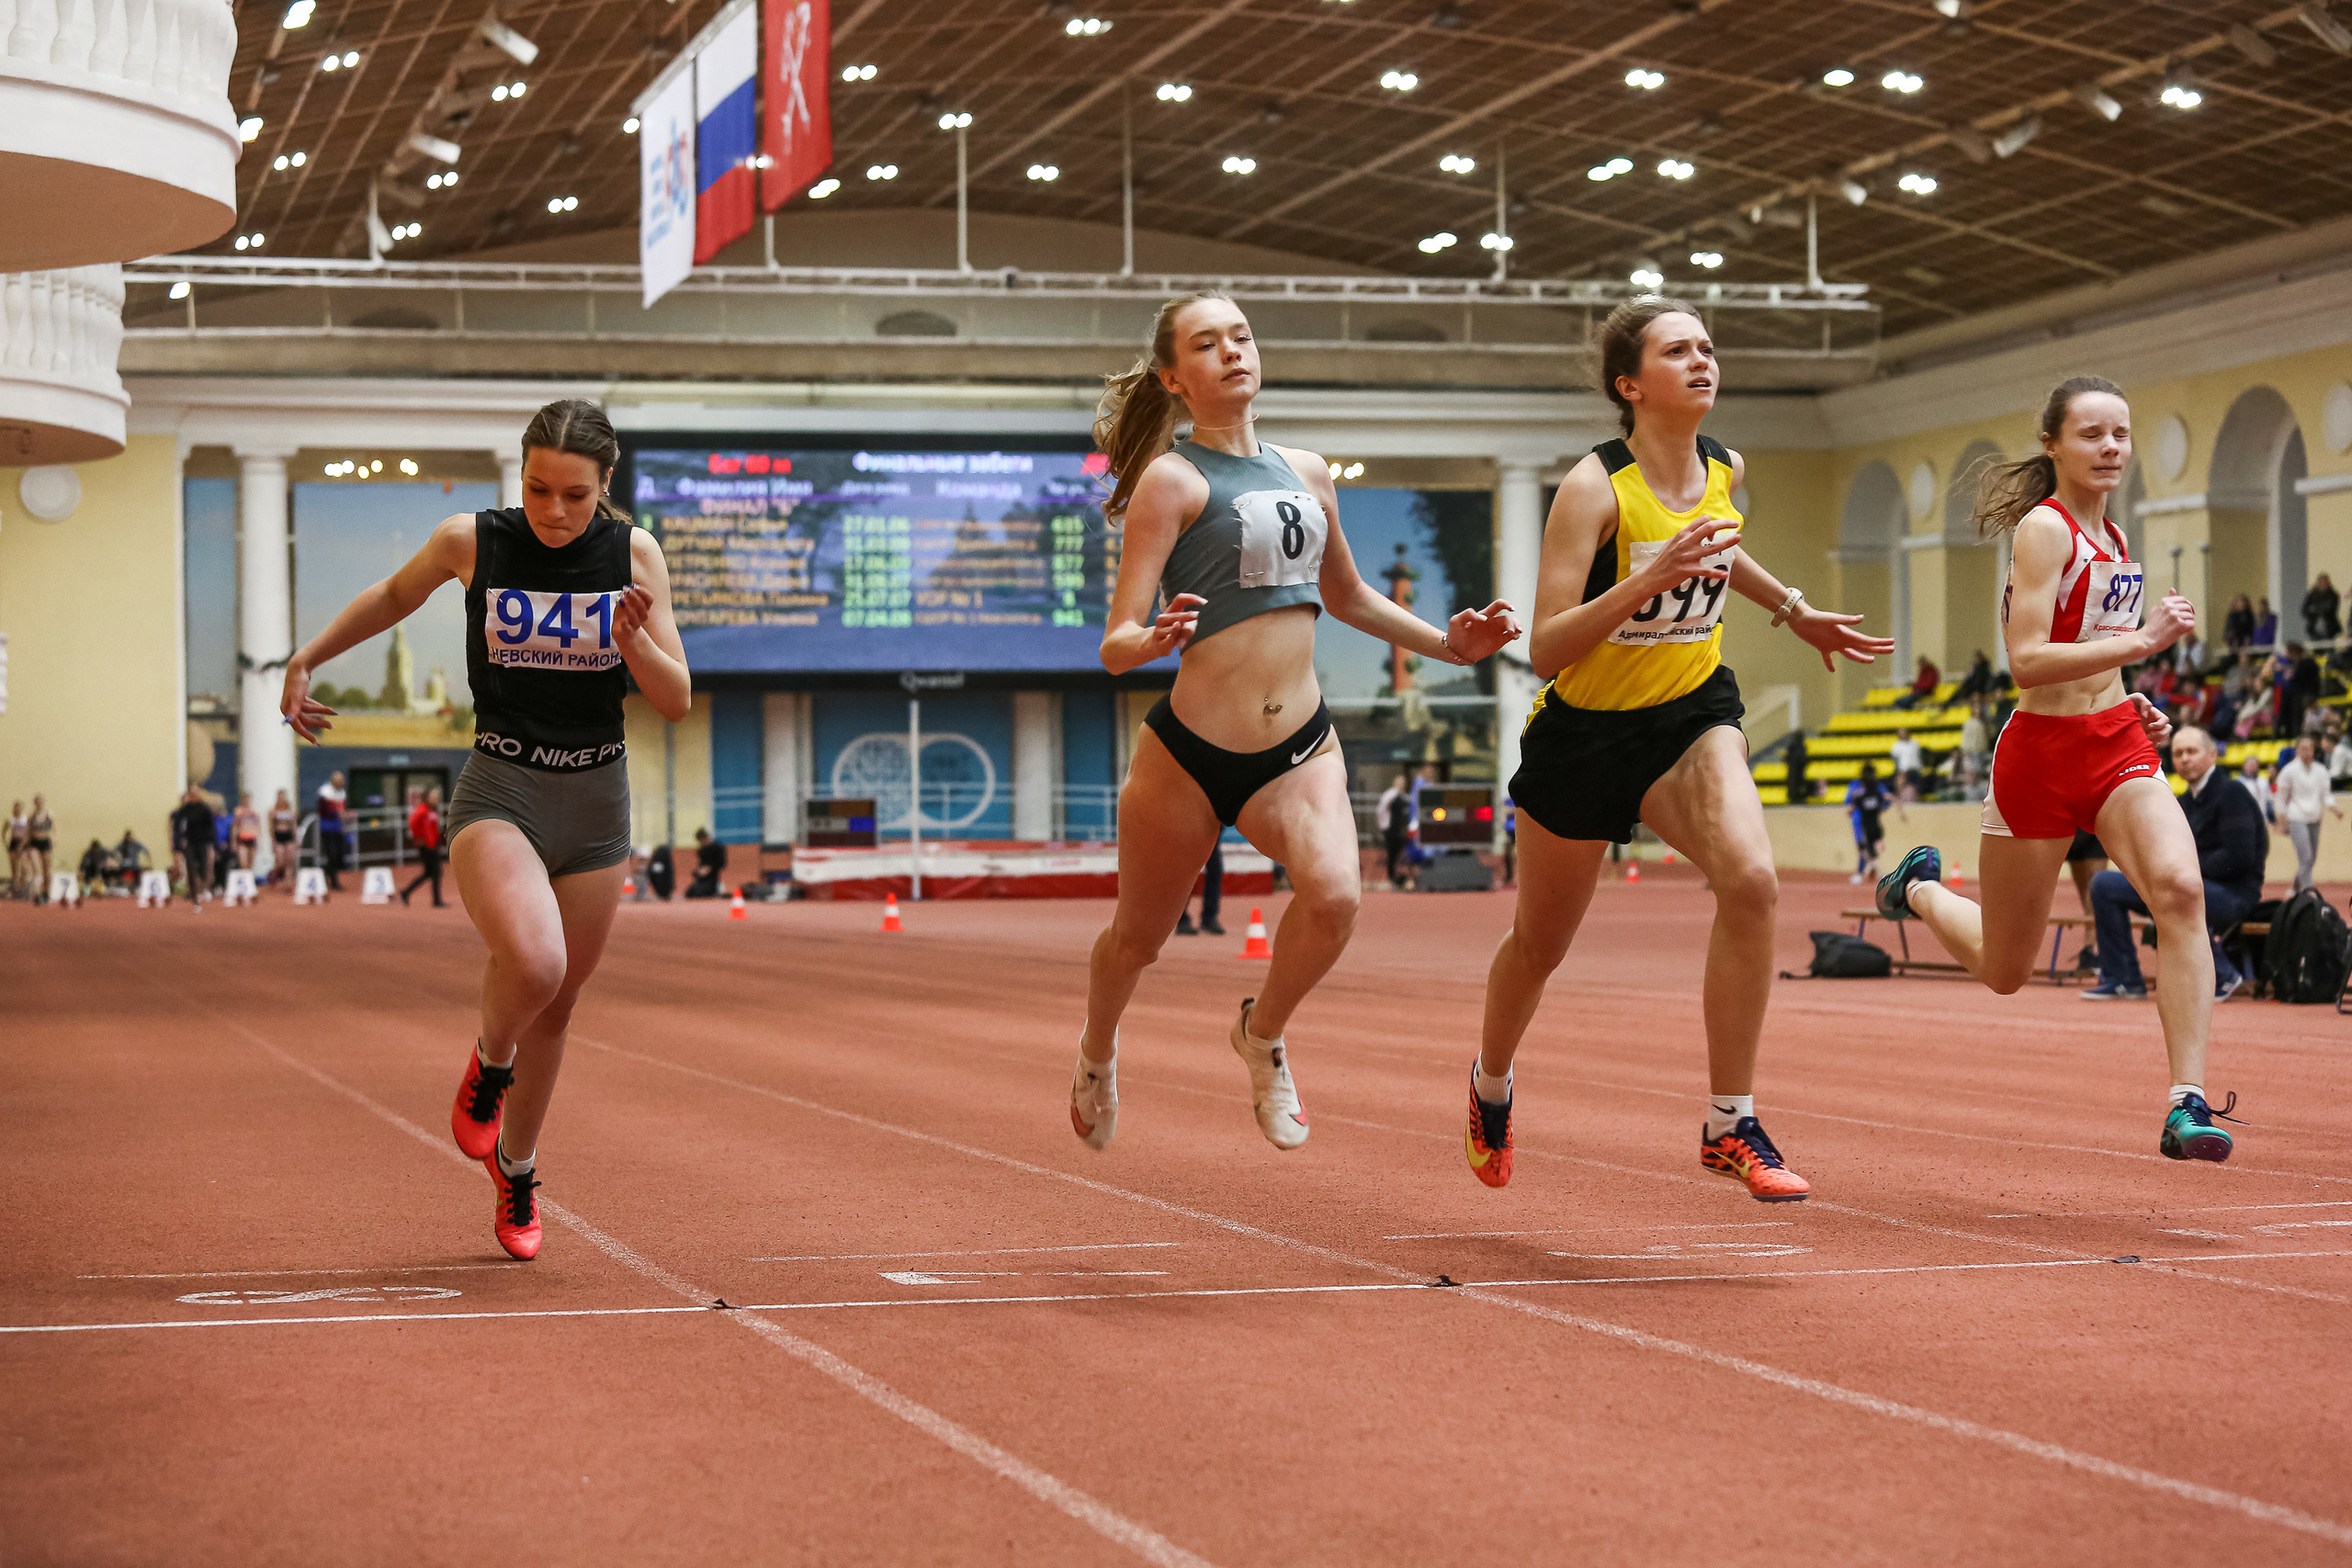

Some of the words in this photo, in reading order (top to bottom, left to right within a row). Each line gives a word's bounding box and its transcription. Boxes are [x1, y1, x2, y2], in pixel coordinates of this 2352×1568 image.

[853, 451, 965, 473] Финальные
[967, 450, 1034, 473] забеги
[935, 479, 1023, 499] Команда
[1275, 501, 1305, 560] 8
[2102, 573, 2143, 613] 877
[496, 589, 611, 649] 941
[492, 647, 563, 665] НЕВСКИЙ
[568, 650, 621, 668] РАЙОН
[530, 745, 597, 768] NIKE
